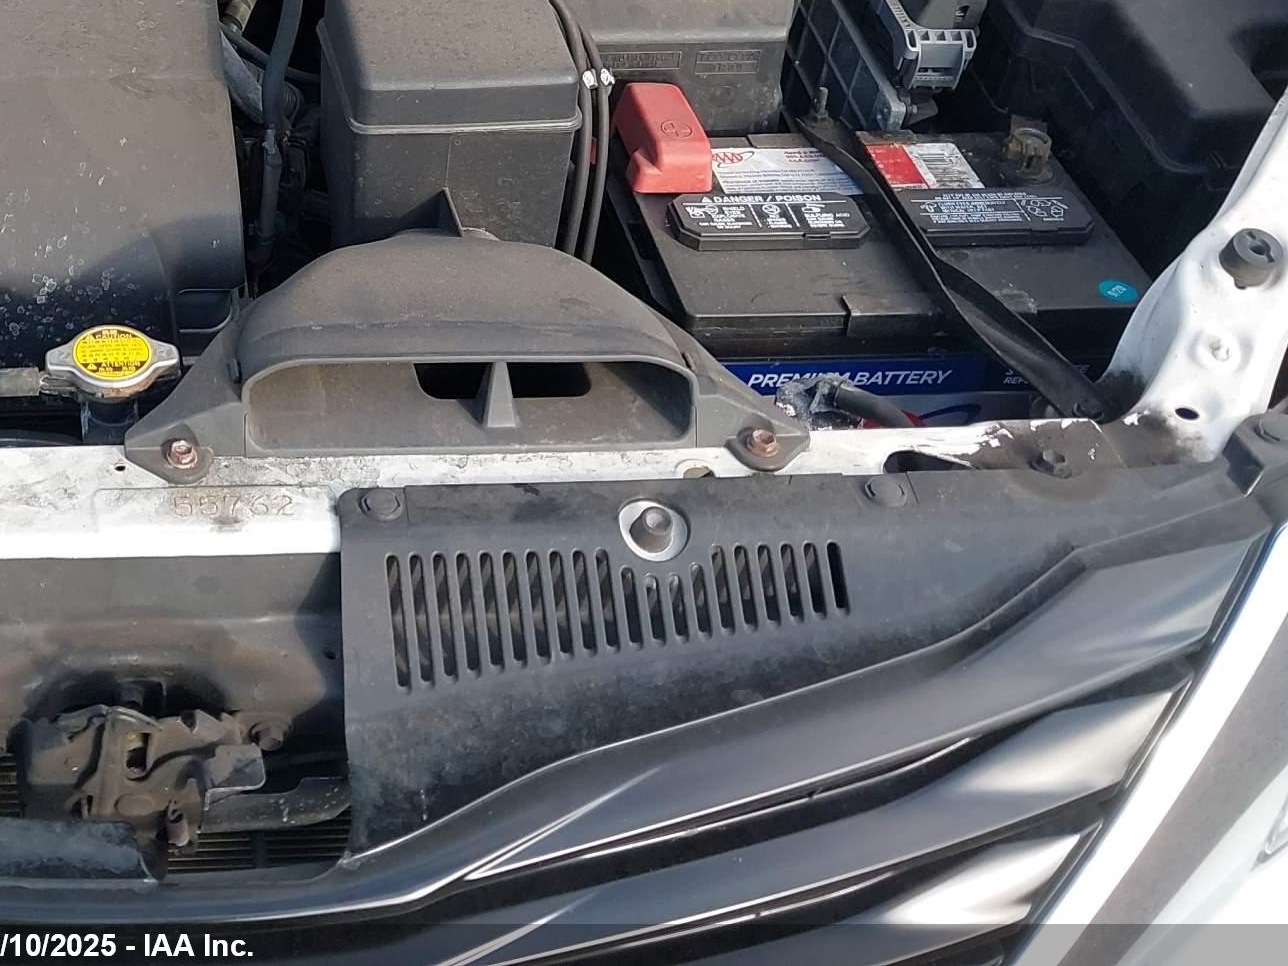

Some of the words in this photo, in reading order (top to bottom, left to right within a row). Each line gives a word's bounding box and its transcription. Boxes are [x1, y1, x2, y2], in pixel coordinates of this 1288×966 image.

[775, 194, 822, 202] POISON
[747, 371, 851, 388] PREM
[853, 369, 953, 386] BATTERY
